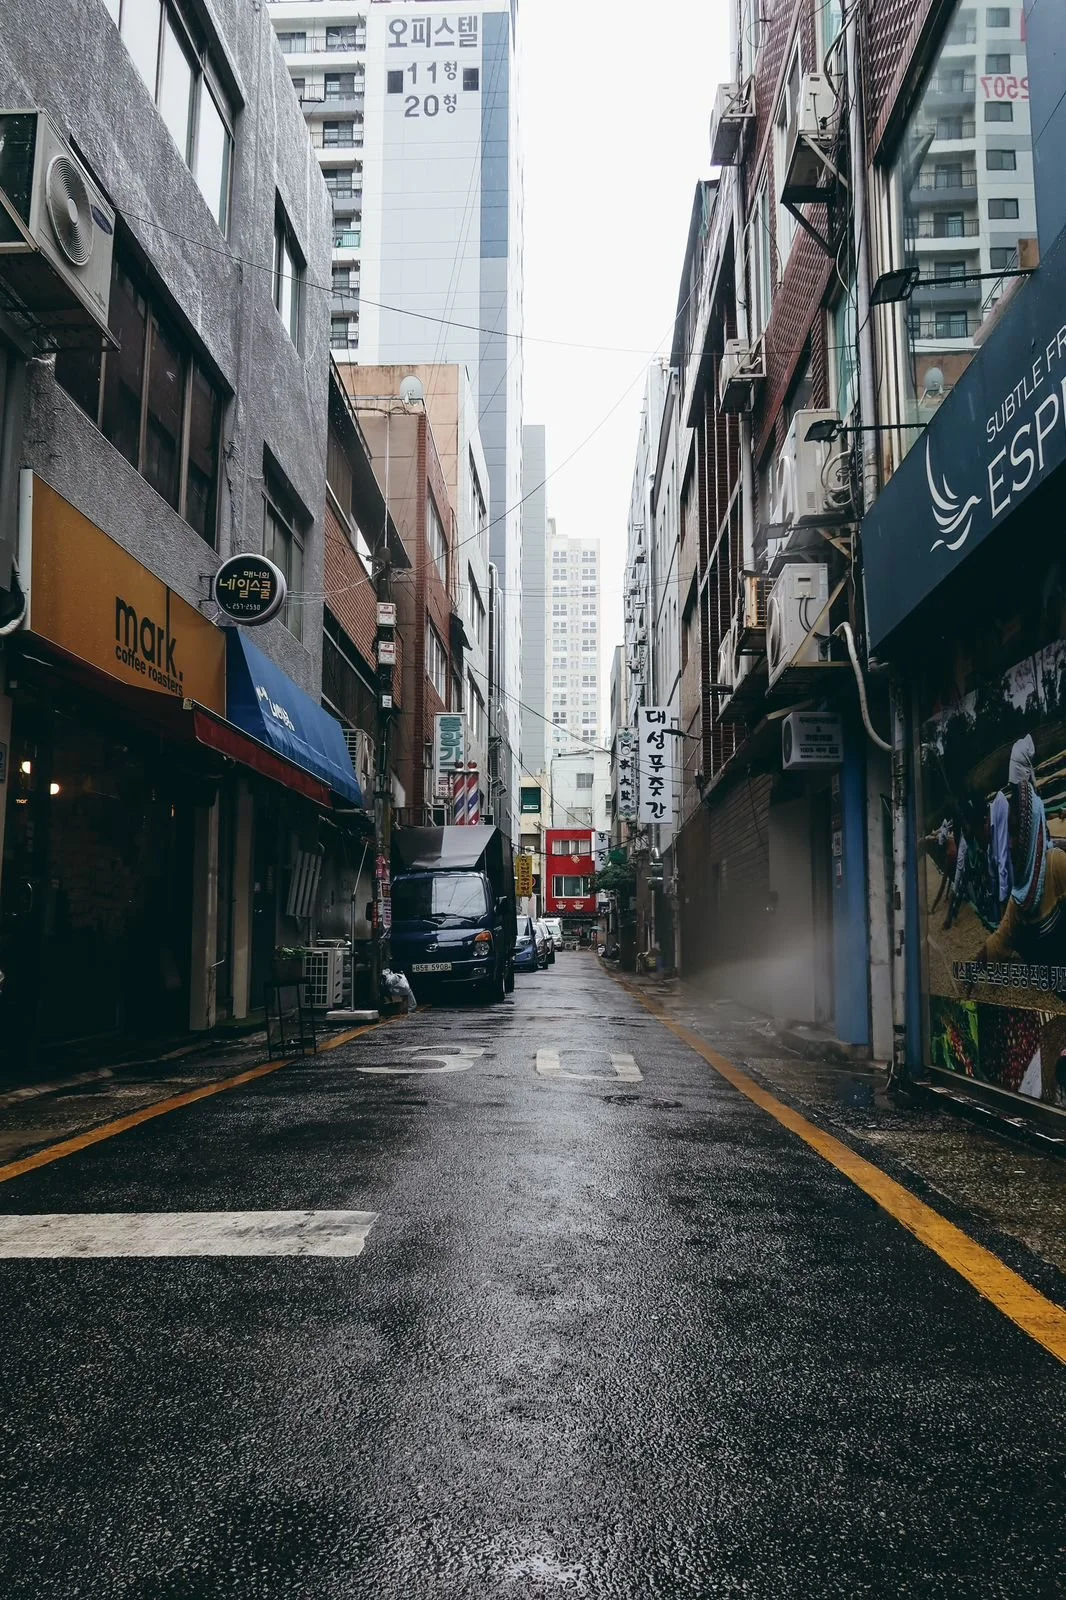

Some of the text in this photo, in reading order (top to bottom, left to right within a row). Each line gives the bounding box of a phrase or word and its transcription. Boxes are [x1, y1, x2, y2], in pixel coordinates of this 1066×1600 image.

[387, 15, 478, 48] 오피스텔
[406, 61, 458, 85] 11형
[404, 93, 458, 118] 20형
[986, 356, 1044, 443] SUBTLE
[987, 377, 1066, 519] ESP
[219, 578, 271, 600] 네일스쿨
[115, 645, 183, 696] coffee roasters
[645, 710, 667, 819] 대성푸줏간
